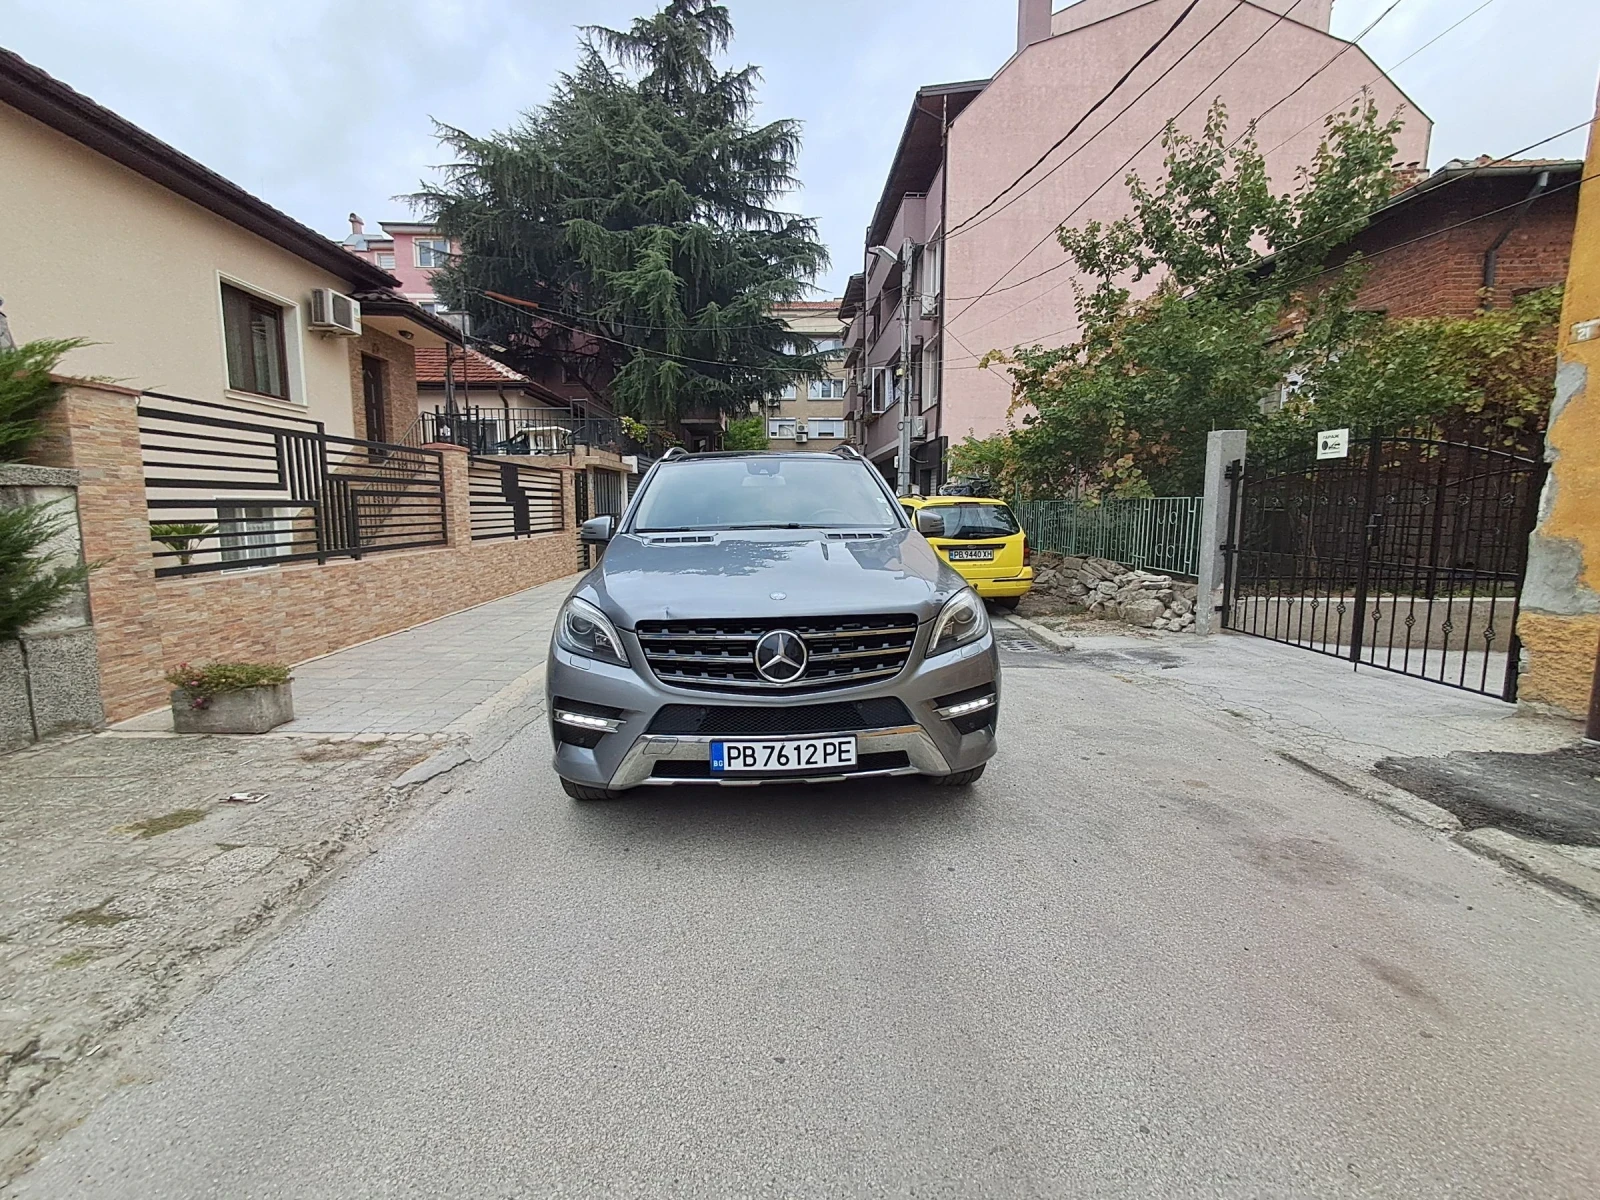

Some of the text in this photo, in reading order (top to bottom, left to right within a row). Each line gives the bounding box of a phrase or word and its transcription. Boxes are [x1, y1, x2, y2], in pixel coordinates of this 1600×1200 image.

[954, 550, 992, 559] PB 9440 XH
[727, 740, 852, 767] PB 7612 PE
